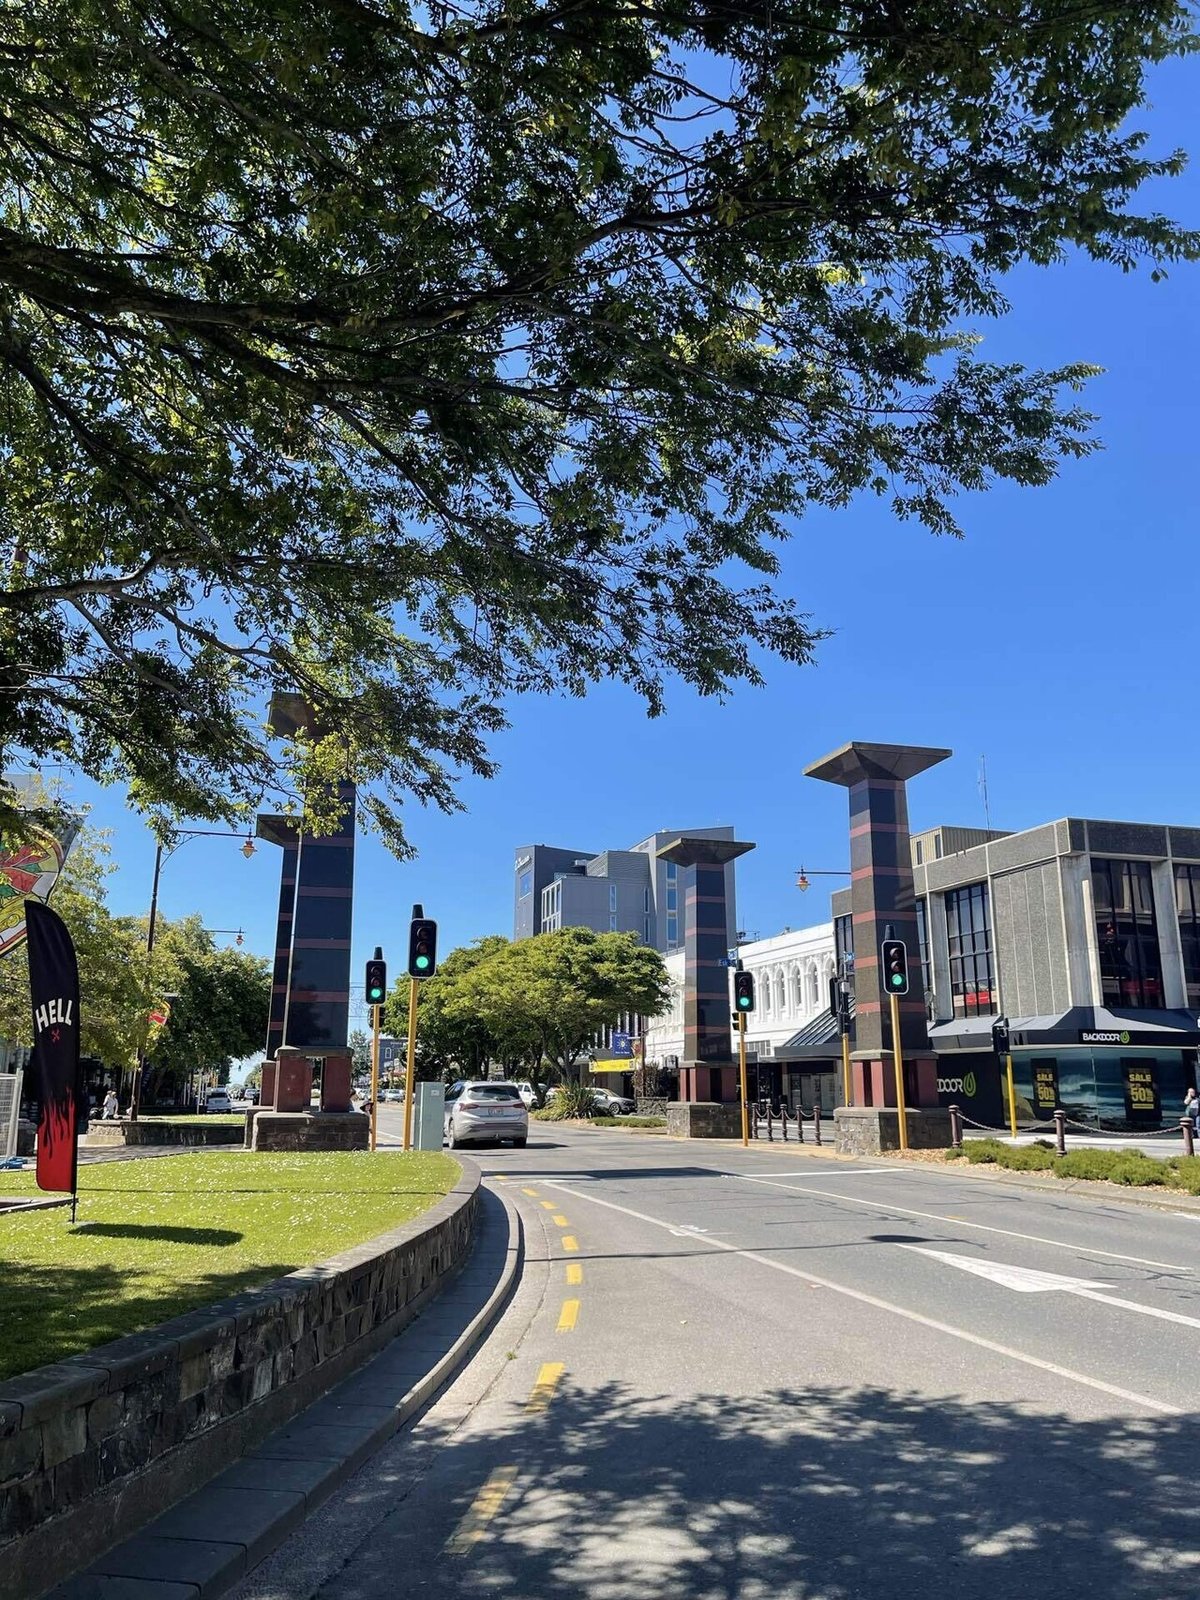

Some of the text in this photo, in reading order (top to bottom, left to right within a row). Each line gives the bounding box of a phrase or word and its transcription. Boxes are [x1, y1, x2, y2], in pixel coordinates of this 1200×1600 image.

[35, 998, 73, 1033] HELL
[1082, 1032, 1121, 1042] BACKDOOR
[1129, 1073, 1152, 1082] SALE
[936, 1078, 964, 1093] DOOR
